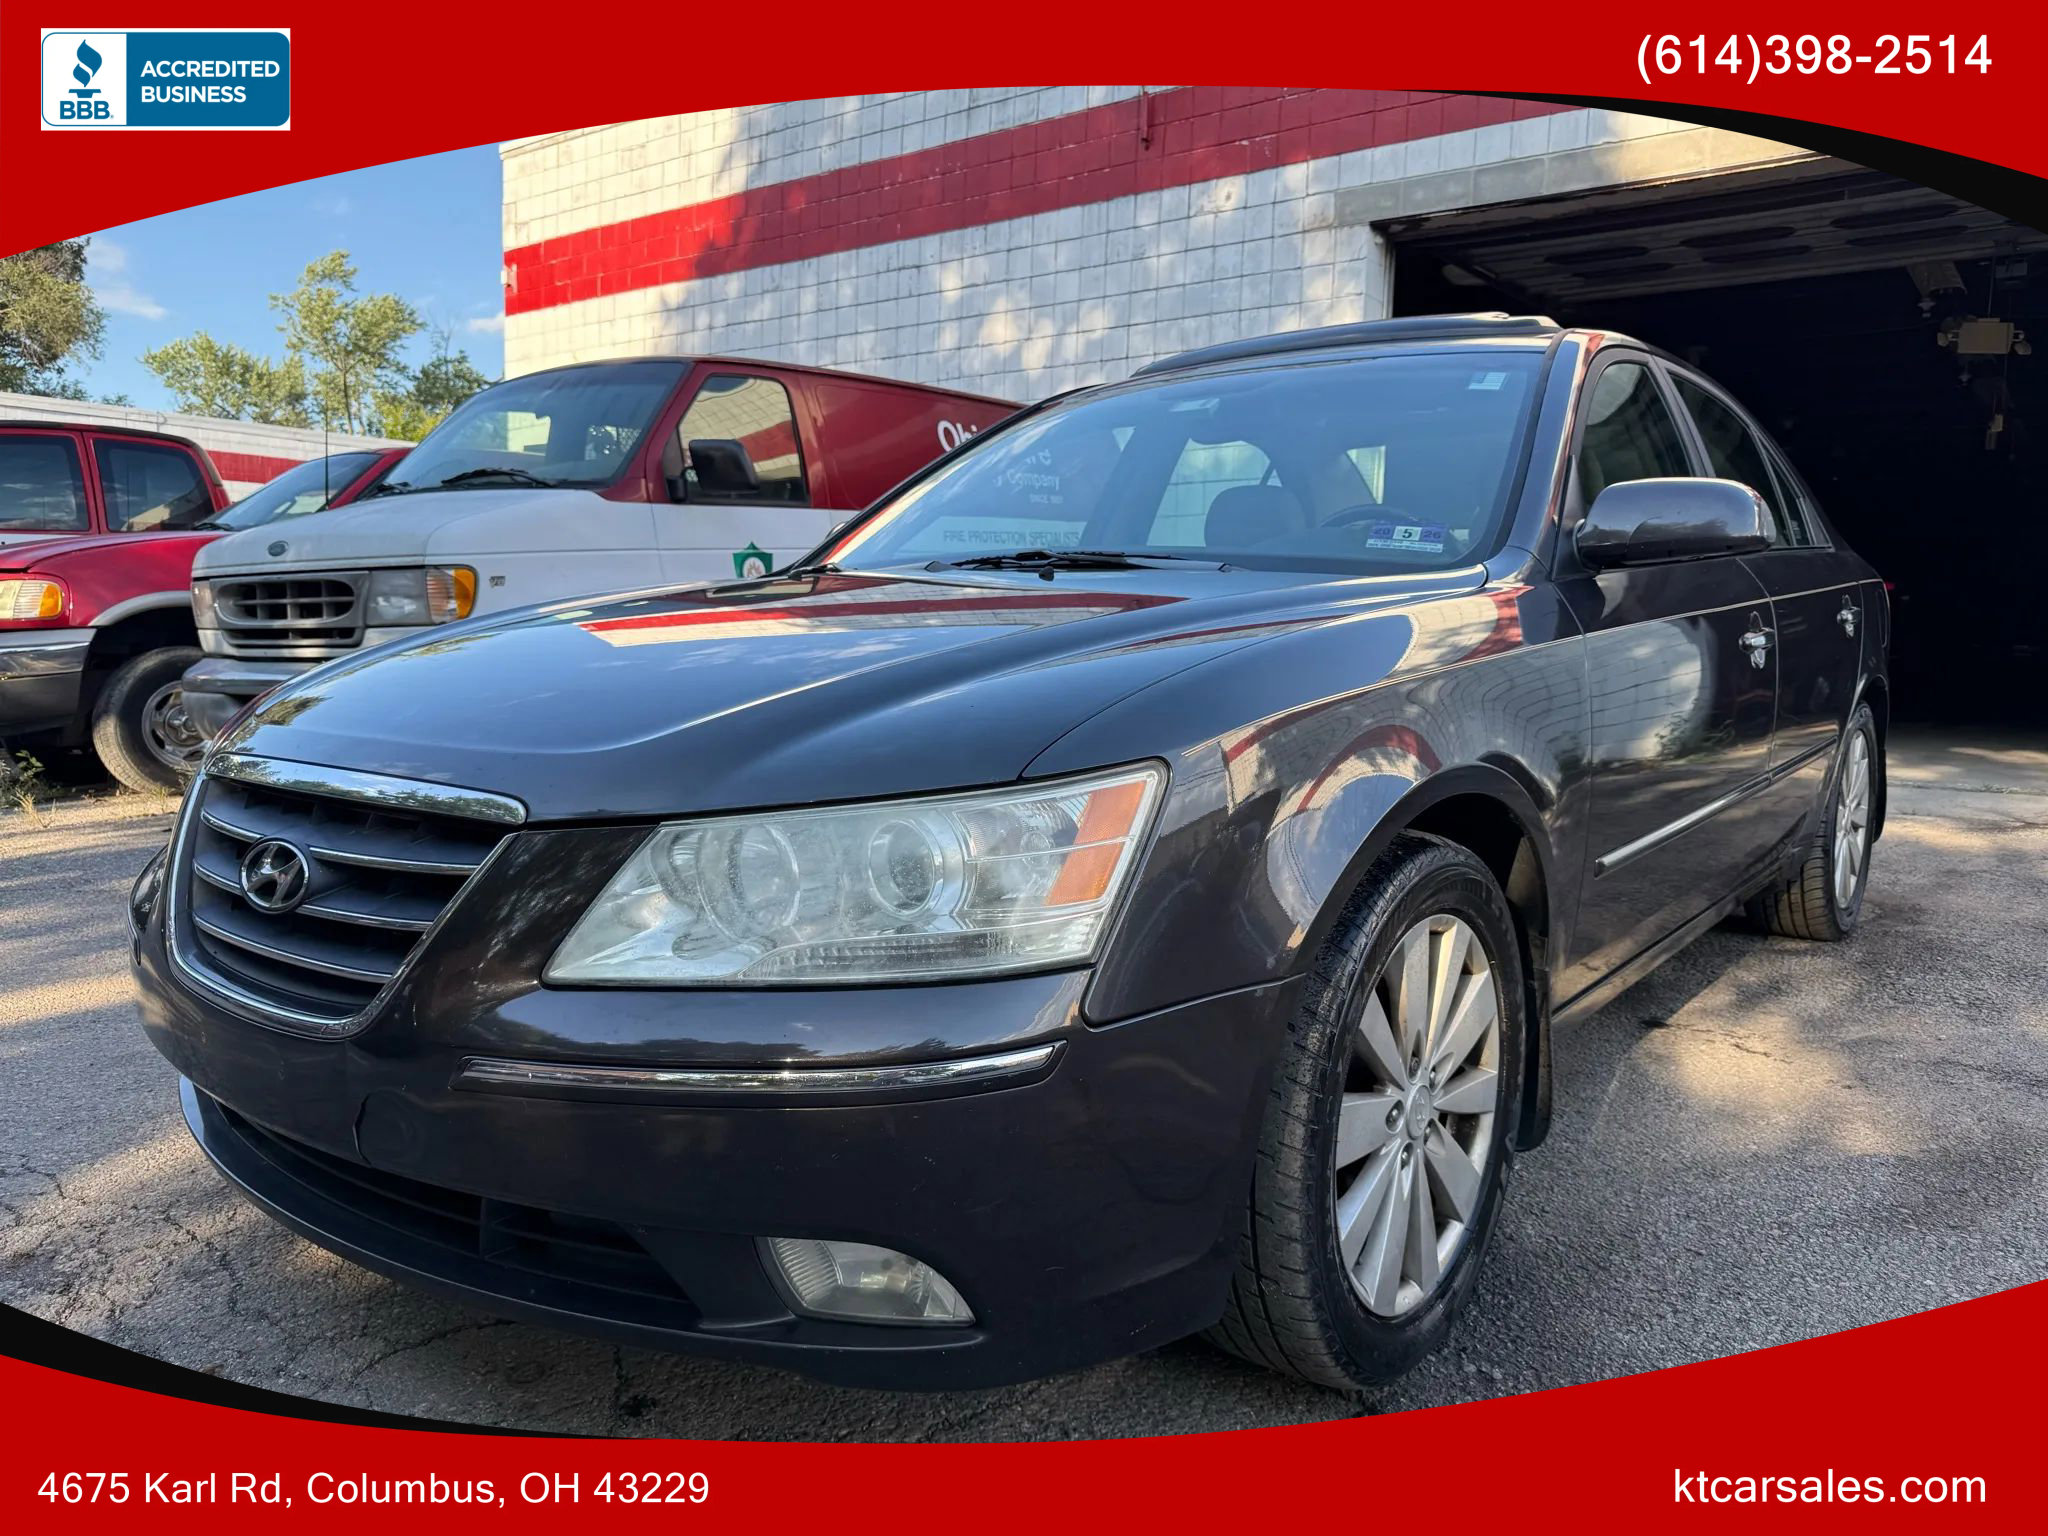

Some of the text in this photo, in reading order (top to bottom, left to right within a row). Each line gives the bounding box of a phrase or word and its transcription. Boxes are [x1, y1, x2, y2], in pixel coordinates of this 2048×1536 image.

[1007, 469, 1061, 491] Company
[943, 530, 966, 543] FIRE
[967, 530, 1027, 546] PROTECTION
[1029, 531, 1081, 547] SPECIALISTS
[1402, 528, 1413, 539] 5
